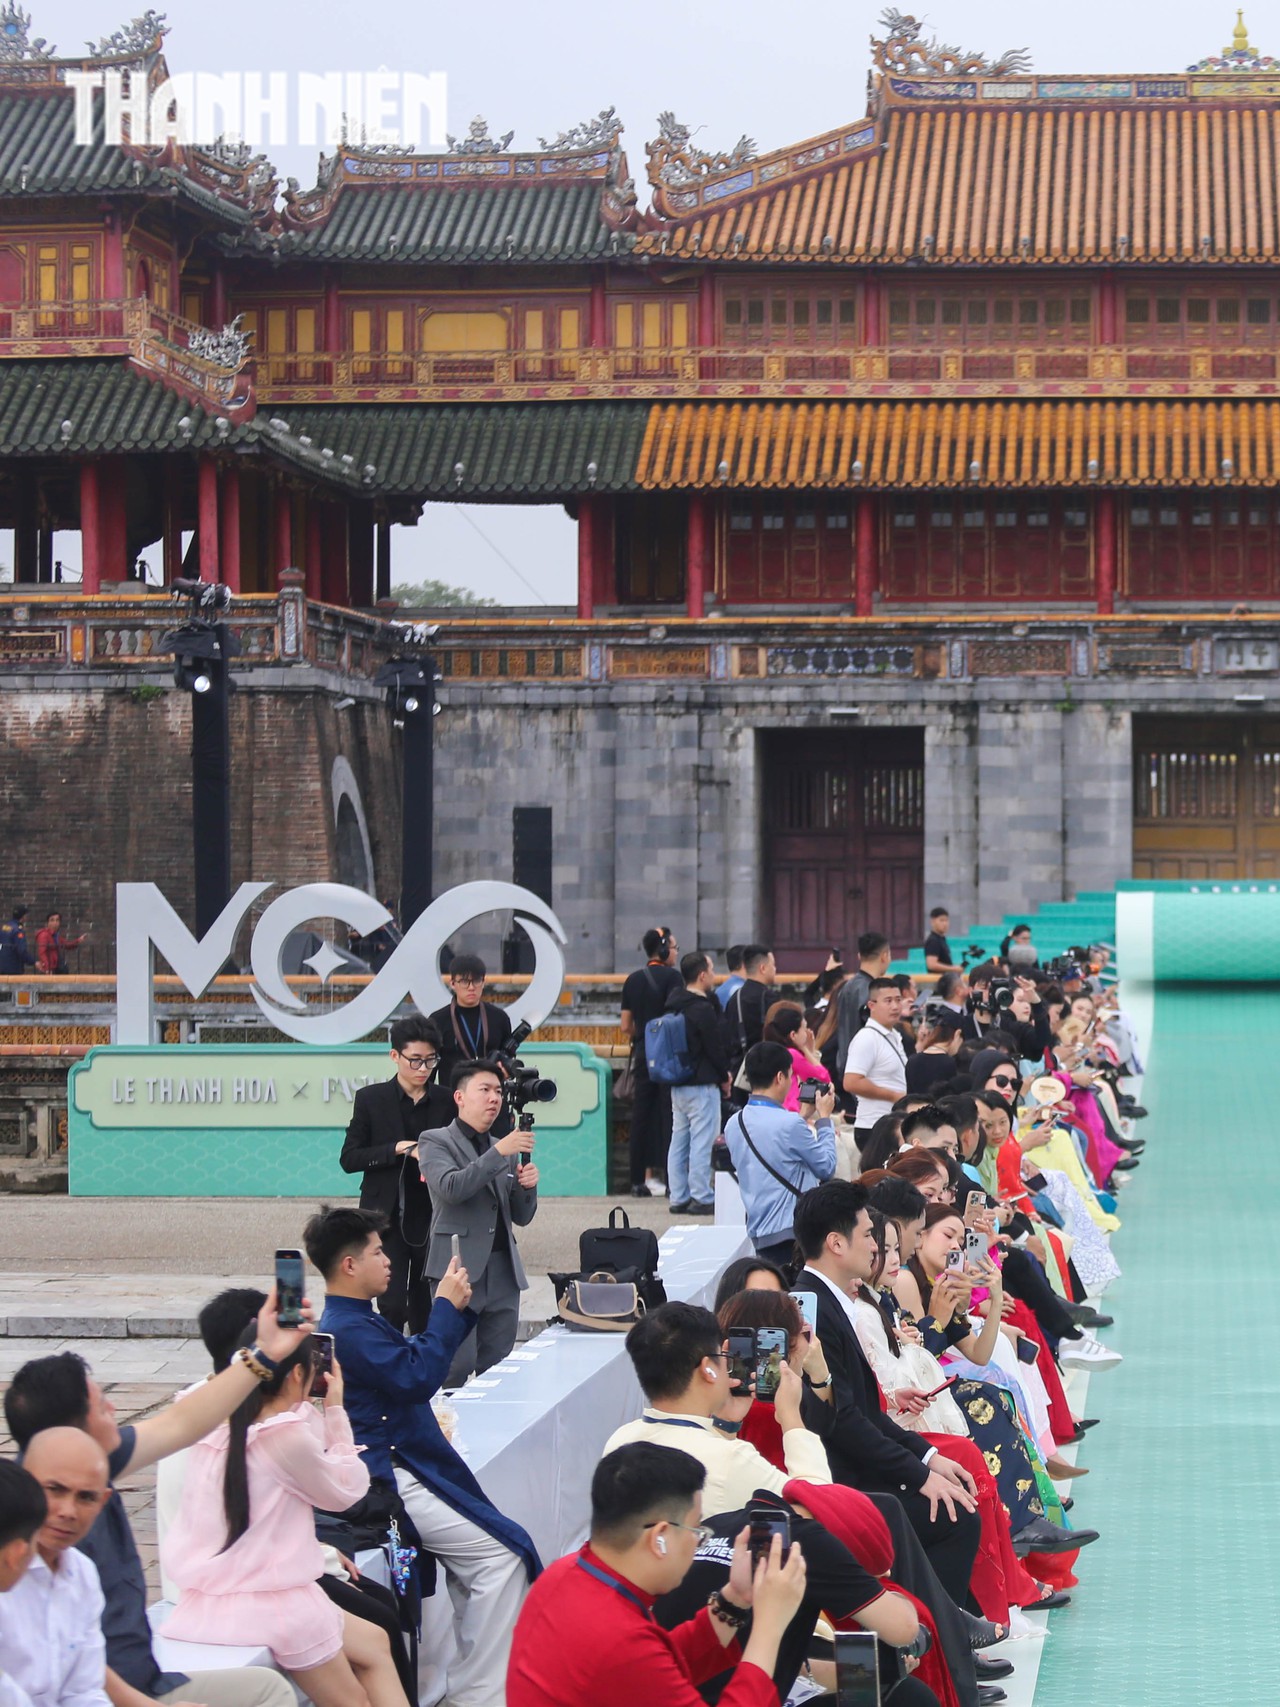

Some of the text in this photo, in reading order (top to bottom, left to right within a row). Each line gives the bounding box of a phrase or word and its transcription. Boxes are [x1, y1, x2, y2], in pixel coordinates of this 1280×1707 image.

[112, 1077, 136, 1104] LE
[146, 1077, 223, 1104] THANH
[233, 1077, 277, 1104] HOA
